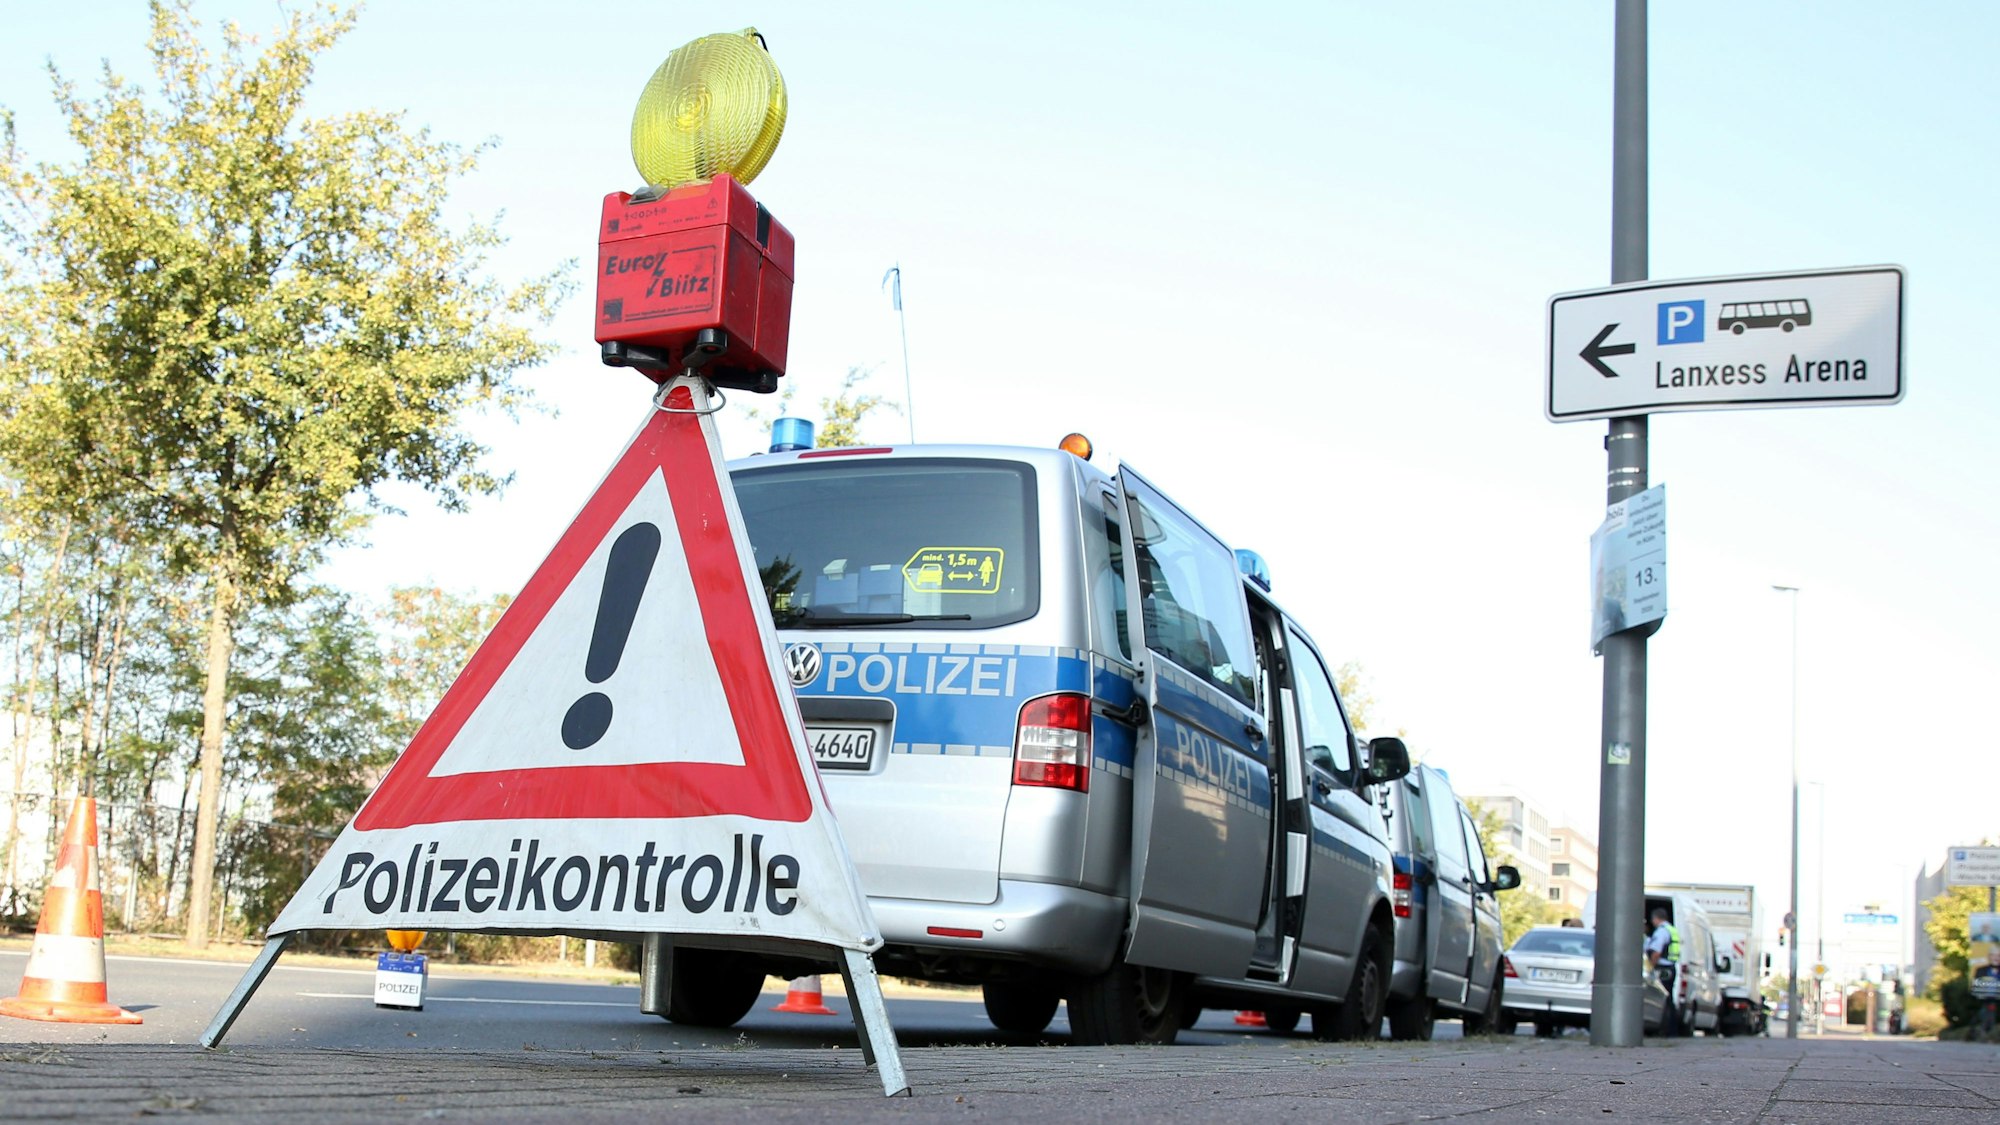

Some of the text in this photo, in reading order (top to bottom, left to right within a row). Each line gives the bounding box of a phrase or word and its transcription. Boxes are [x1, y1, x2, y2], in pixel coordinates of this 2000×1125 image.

[605, 255, 655, 275] Euro
[1667, 305, 1695, 341] P
[1655, 354, 1867, 389] Lanxess Arena
[922, 553, 945, 562] mind.
[1634, 567, 1658, 588] 13.
[826, 654, 1018, 697] POLIZEI
[1174, 722, 1252, 800] POLIZEI
[323, 832, 801, 916] Polizeikontrolle
[379, 982, 419, 995] POLIZEI
